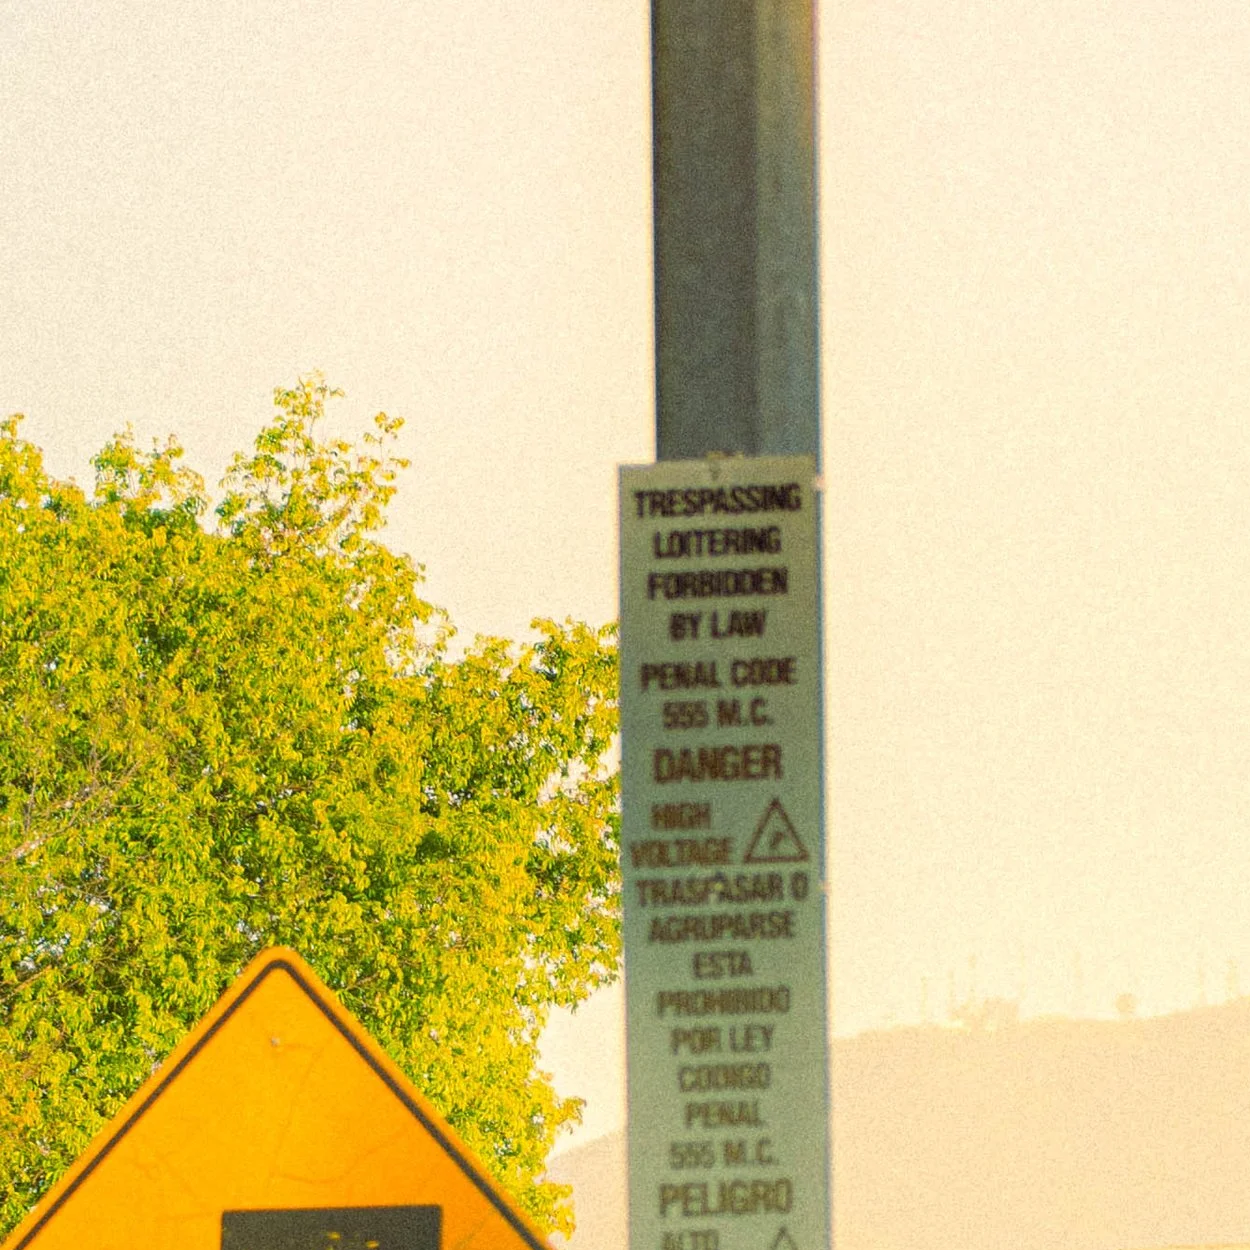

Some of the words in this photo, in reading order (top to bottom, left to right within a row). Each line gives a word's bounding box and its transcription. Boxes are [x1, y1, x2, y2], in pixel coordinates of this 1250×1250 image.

[634, 482, 802, 518] TRESPASSING
[654, 525, 782, 559] LOITERING
[647, 567, 789, 600] FORBIDDEN
[670, 611, 700, 641] BY
[711, 608, 766, 638] LAW
[641, 660, 720, 692] PENAL
[731, 656, 797, 687] CODE
[663, 700, 708, 730] 555
[654, 743, 783, 784] DANGER
[651, 802, 711, 831] HIGH
[631, 836, 733, 868] VOLTAGE
[649, 911, 795, 944] AGRUPARSE
[693, 951, 753, 981] ESTA
[671, 1026, 721, 1056] POR
[729, 1024, 774, 1053] LEY
[686, 1101, 762, 1129] PENAL
[659, 1177, 793, 1219] PELIGRO
